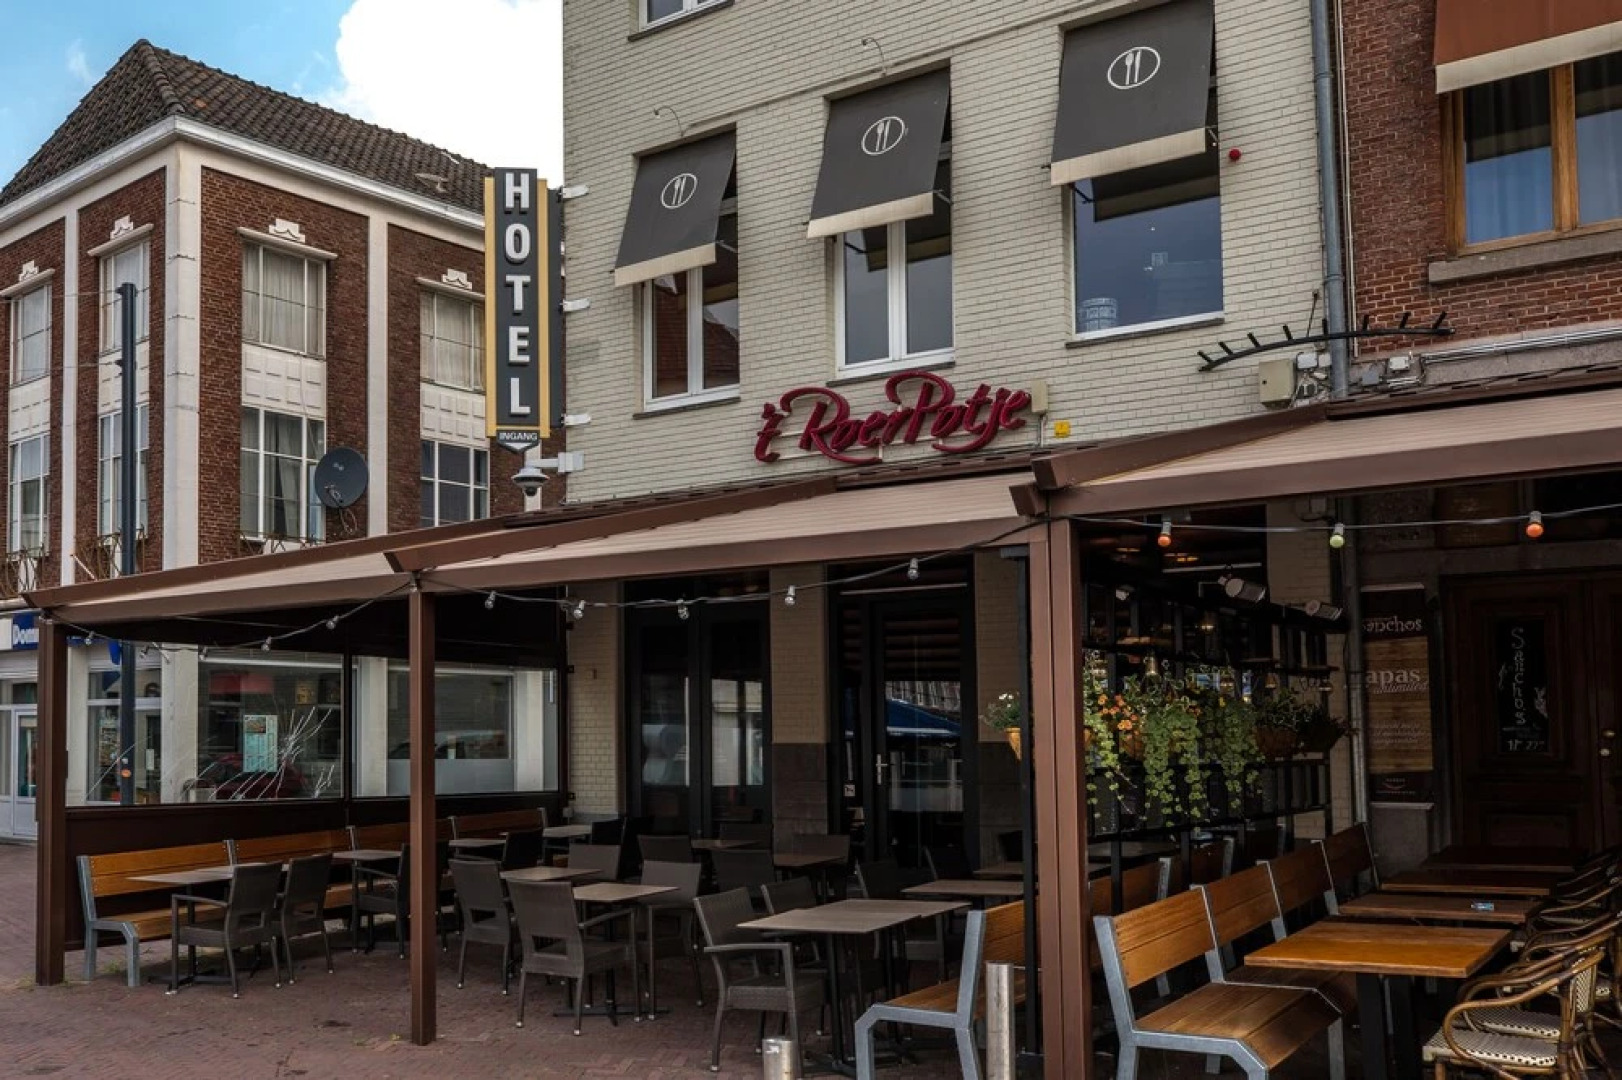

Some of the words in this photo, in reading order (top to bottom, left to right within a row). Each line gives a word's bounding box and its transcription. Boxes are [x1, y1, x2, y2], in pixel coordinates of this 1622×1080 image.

[504, 172, 531, 415] HOTEL
[499, 432, 538, 441] INGANG
[13, 624, 39, 645] Dom
[1365, 668, 1421, 691] apas
